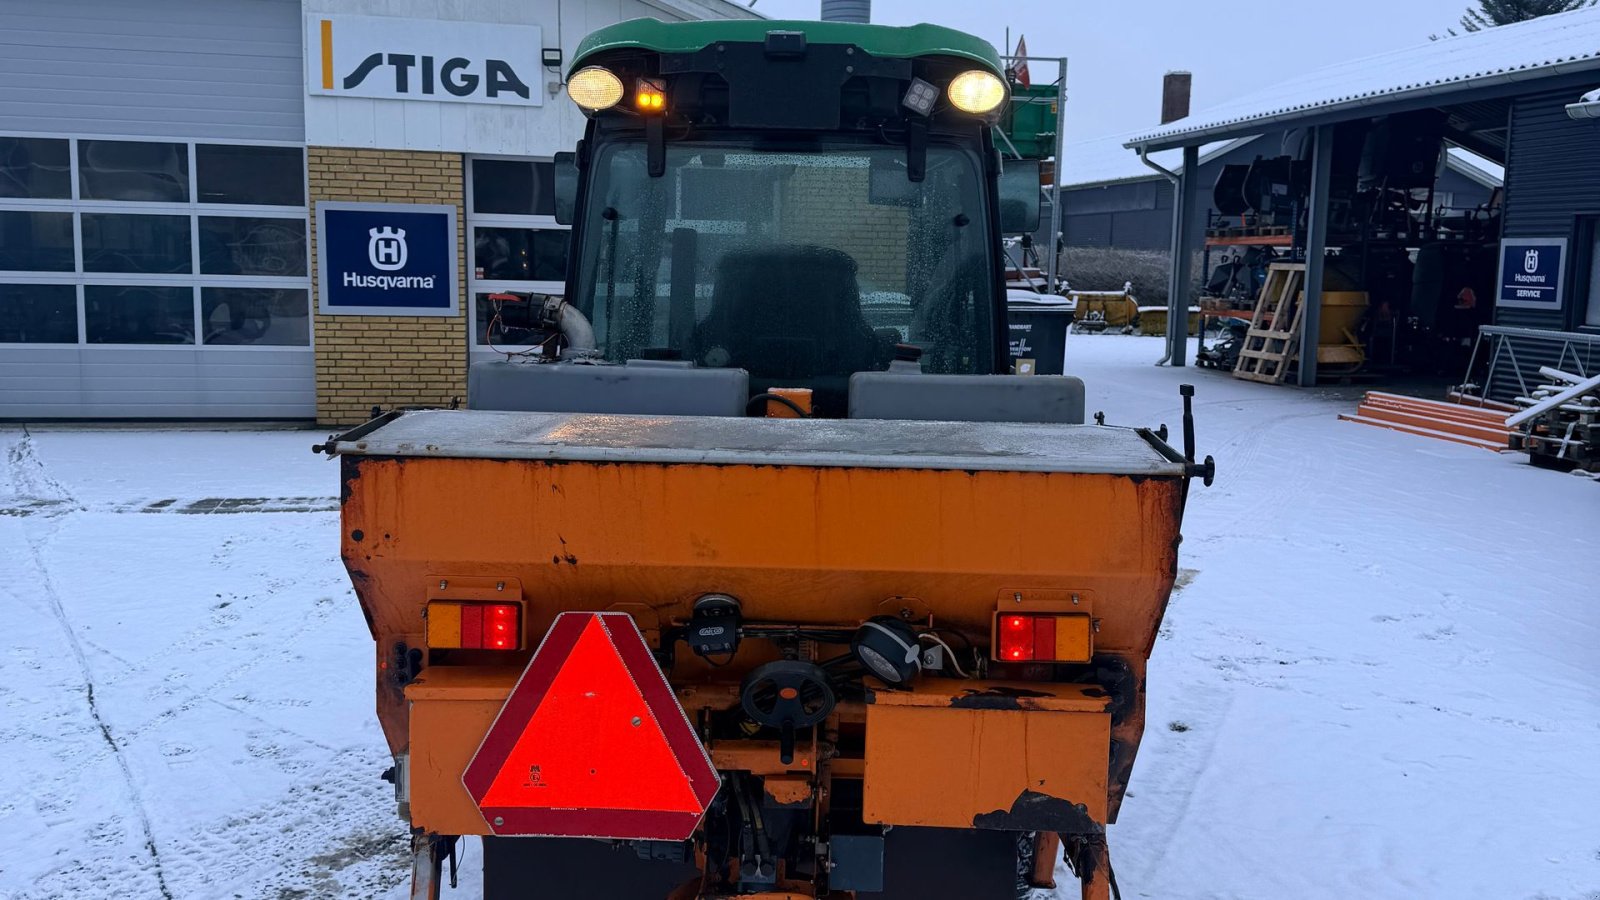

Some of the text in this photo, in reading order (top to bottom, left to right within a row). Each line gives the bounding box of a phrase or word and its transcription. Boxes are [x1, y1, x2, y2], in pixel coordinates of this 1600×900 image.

[343, 52, 530, 99] STIGA
[378, 240, 398, 262] H
[1516, 289, 1541, 298] SERVICE
